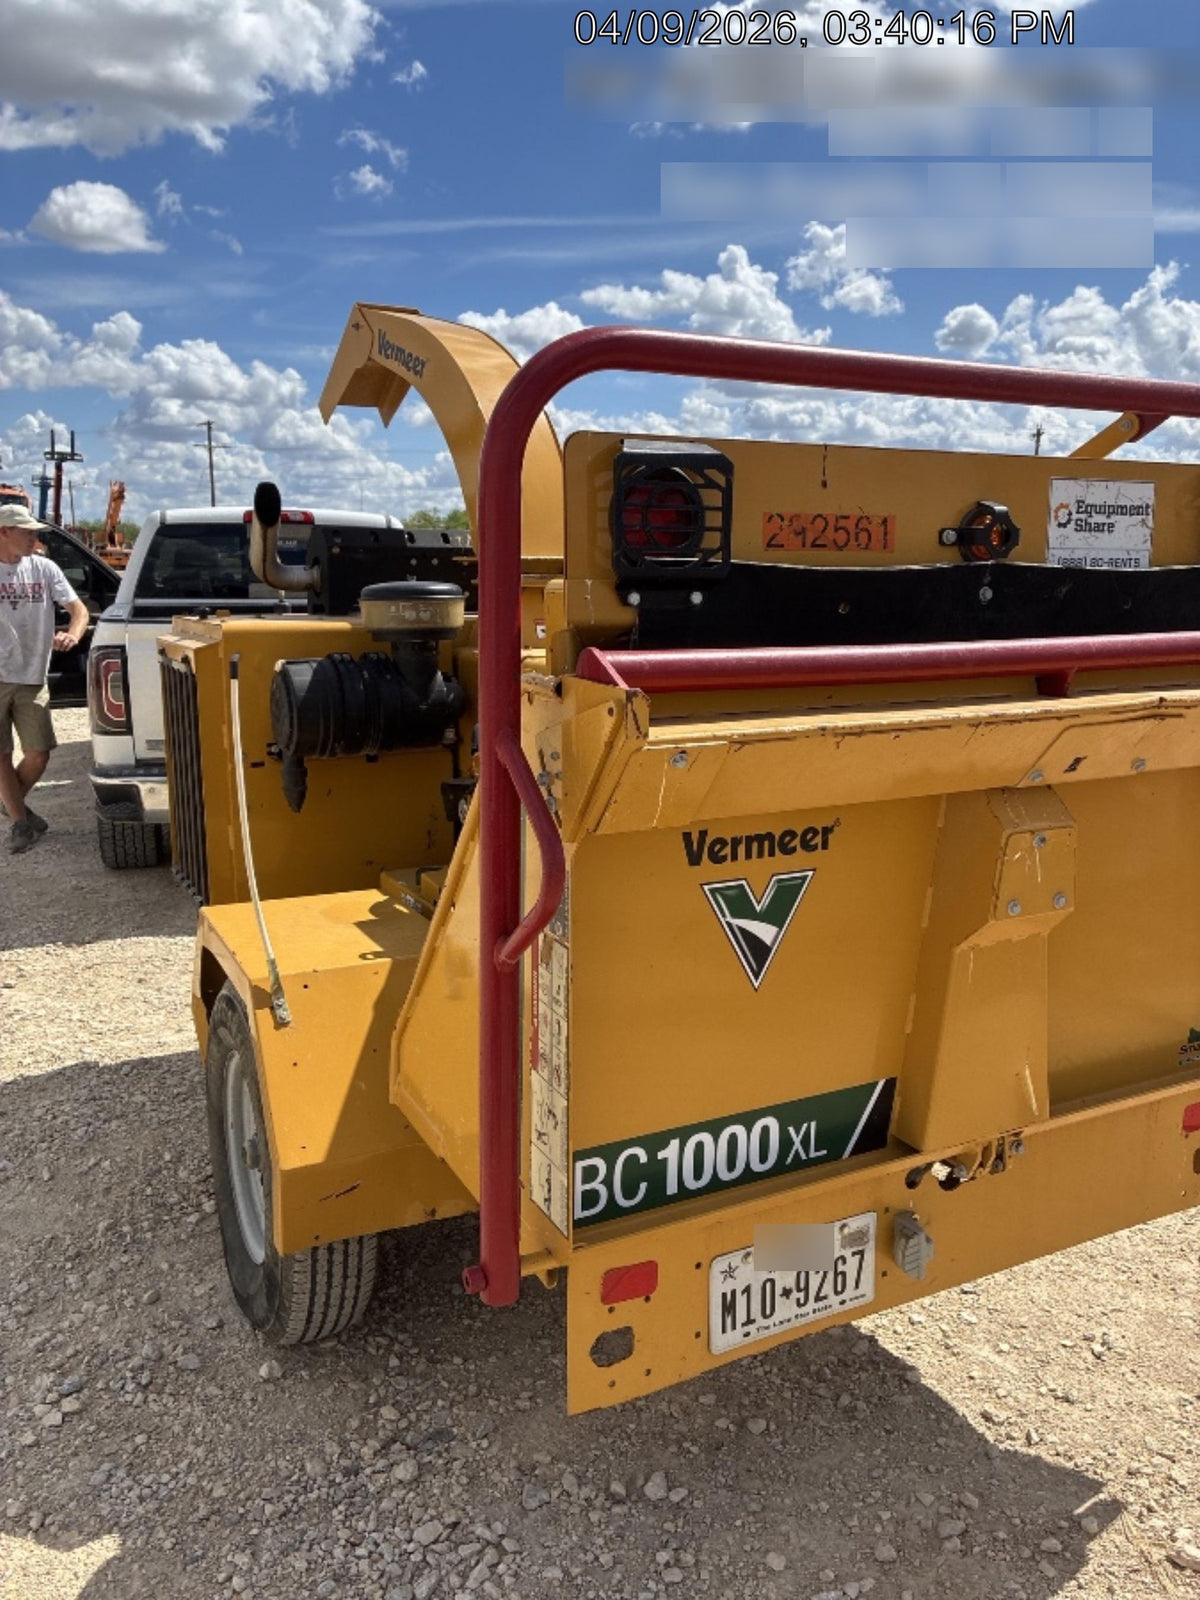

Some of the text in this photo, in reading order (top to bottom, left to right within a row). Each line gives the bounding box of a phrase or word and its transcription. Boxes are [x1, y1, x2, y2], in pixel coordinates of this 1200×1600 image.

[377, 327, 428, 379] Vermeer
[1073, 518, 1117, 534] Share
[1075, 499, 1152, 519] Equipment
[681, 823, 837, 867] Vermeer
[573, 1146, 648, 1221] BC
[656, 1116, 780, 1196] 1000
[785, 1120, 828, 1166] XL
